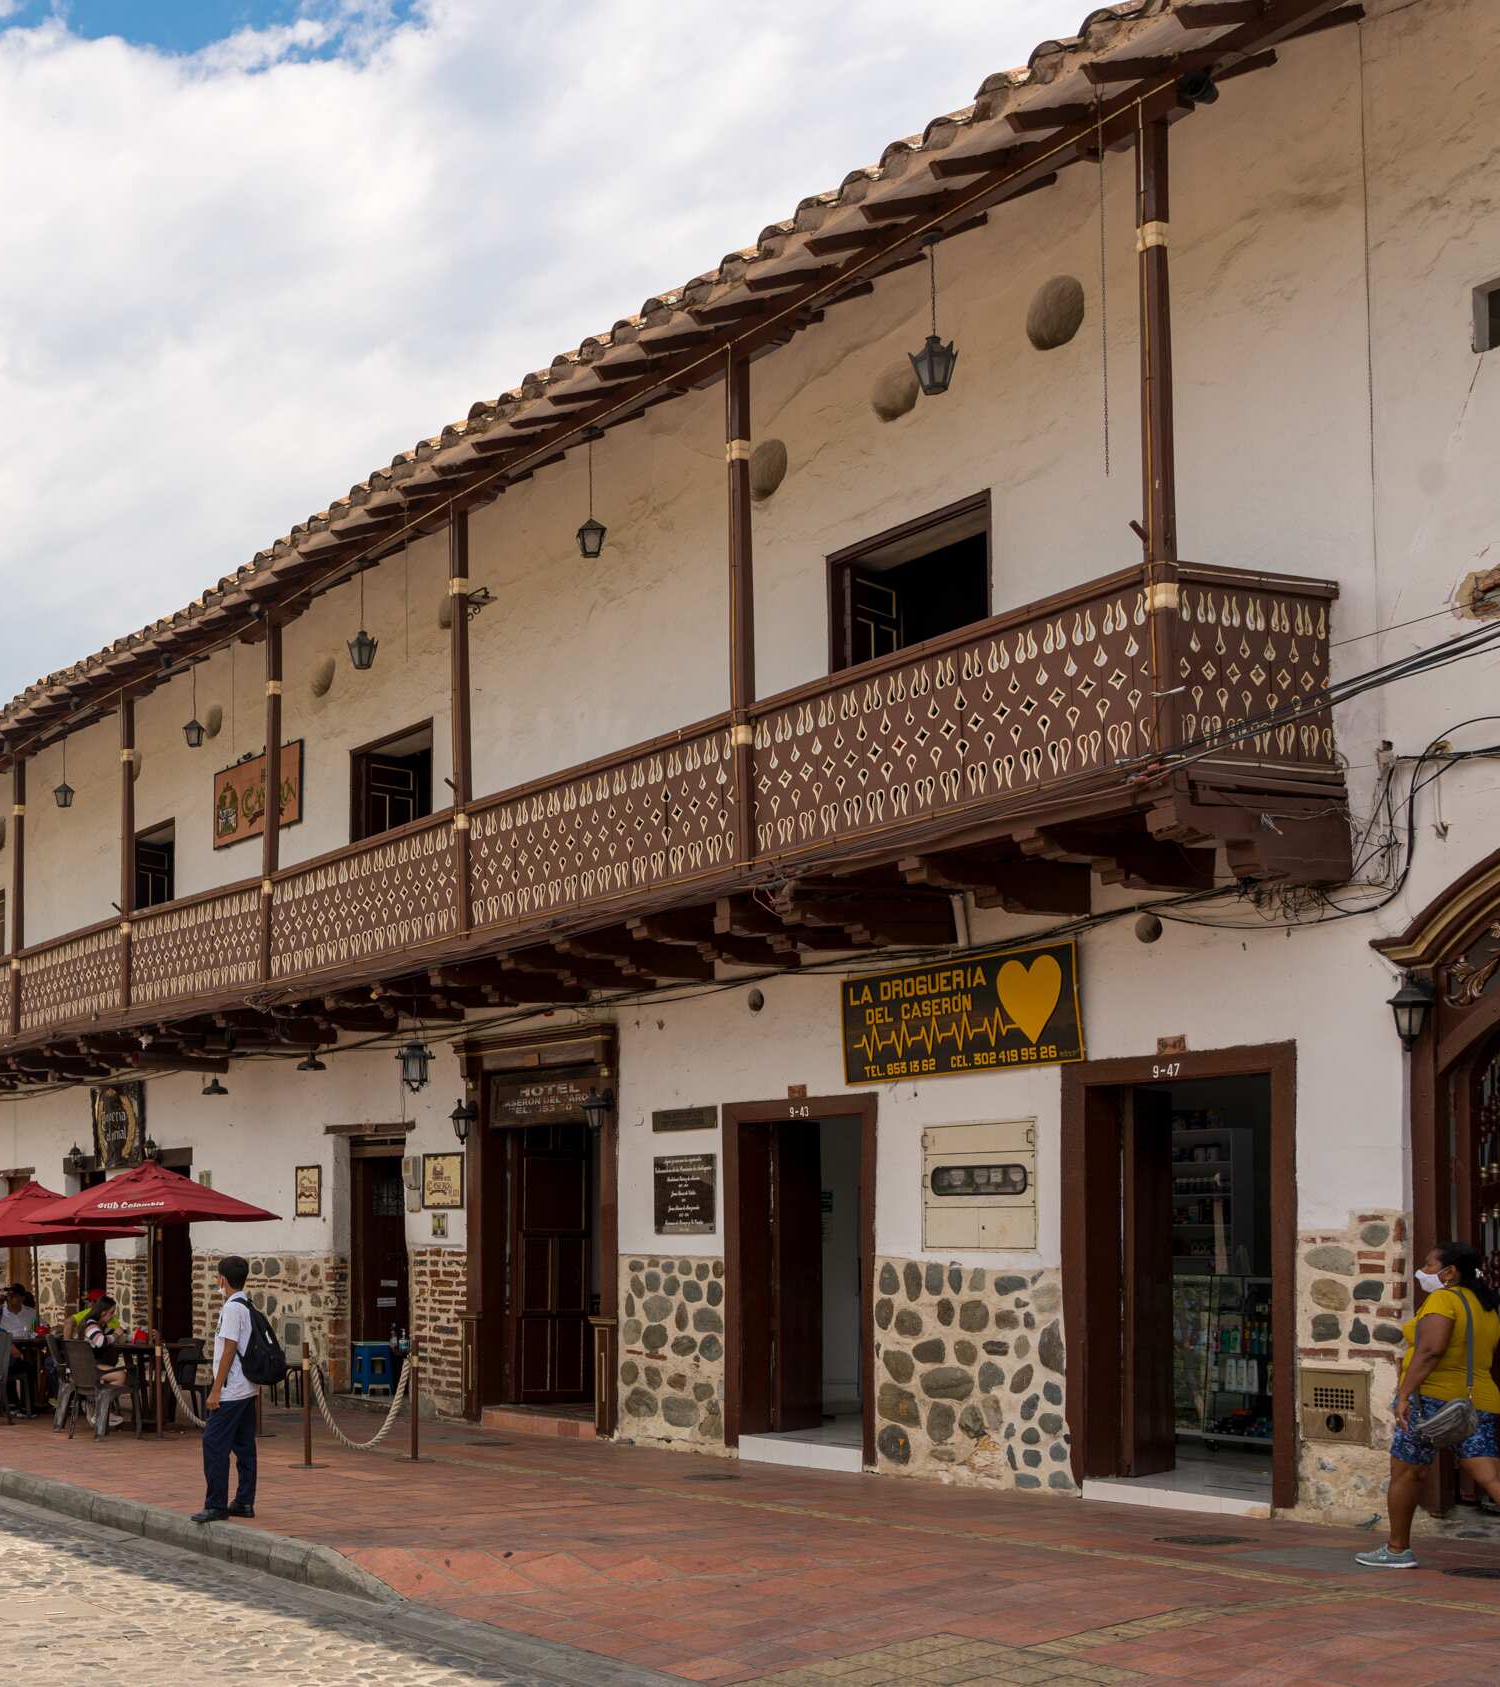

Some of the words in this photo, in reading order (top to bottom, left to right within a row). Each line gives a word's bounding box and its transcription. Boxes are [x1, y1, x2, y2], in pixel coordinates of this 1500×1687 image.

[849, 985, 874, 1006] LA
[880, 966, 987, 1002] DROGUERÍA
[865, 1007, 894, 1025] DEL
[901, 992, 972, 1020] CASERÓN
[864, 1064, 885, 1078] TEL.
[887, 1062, 907, 1076] 853
[921, 1058, 936, 1072] 62
[950, 1054, 972, 1069] CEL.
[974, 1051, 997, 1066] 302
[1021, 1046, 1037, 1061] 95
[1040, 1045, 1057, 1059] 26
[1152, 1063, 1180, 1079] 9-47
[519, 1083, 581, 1097] HOTEL
[789, 1106, 809, 1118] 9-43
